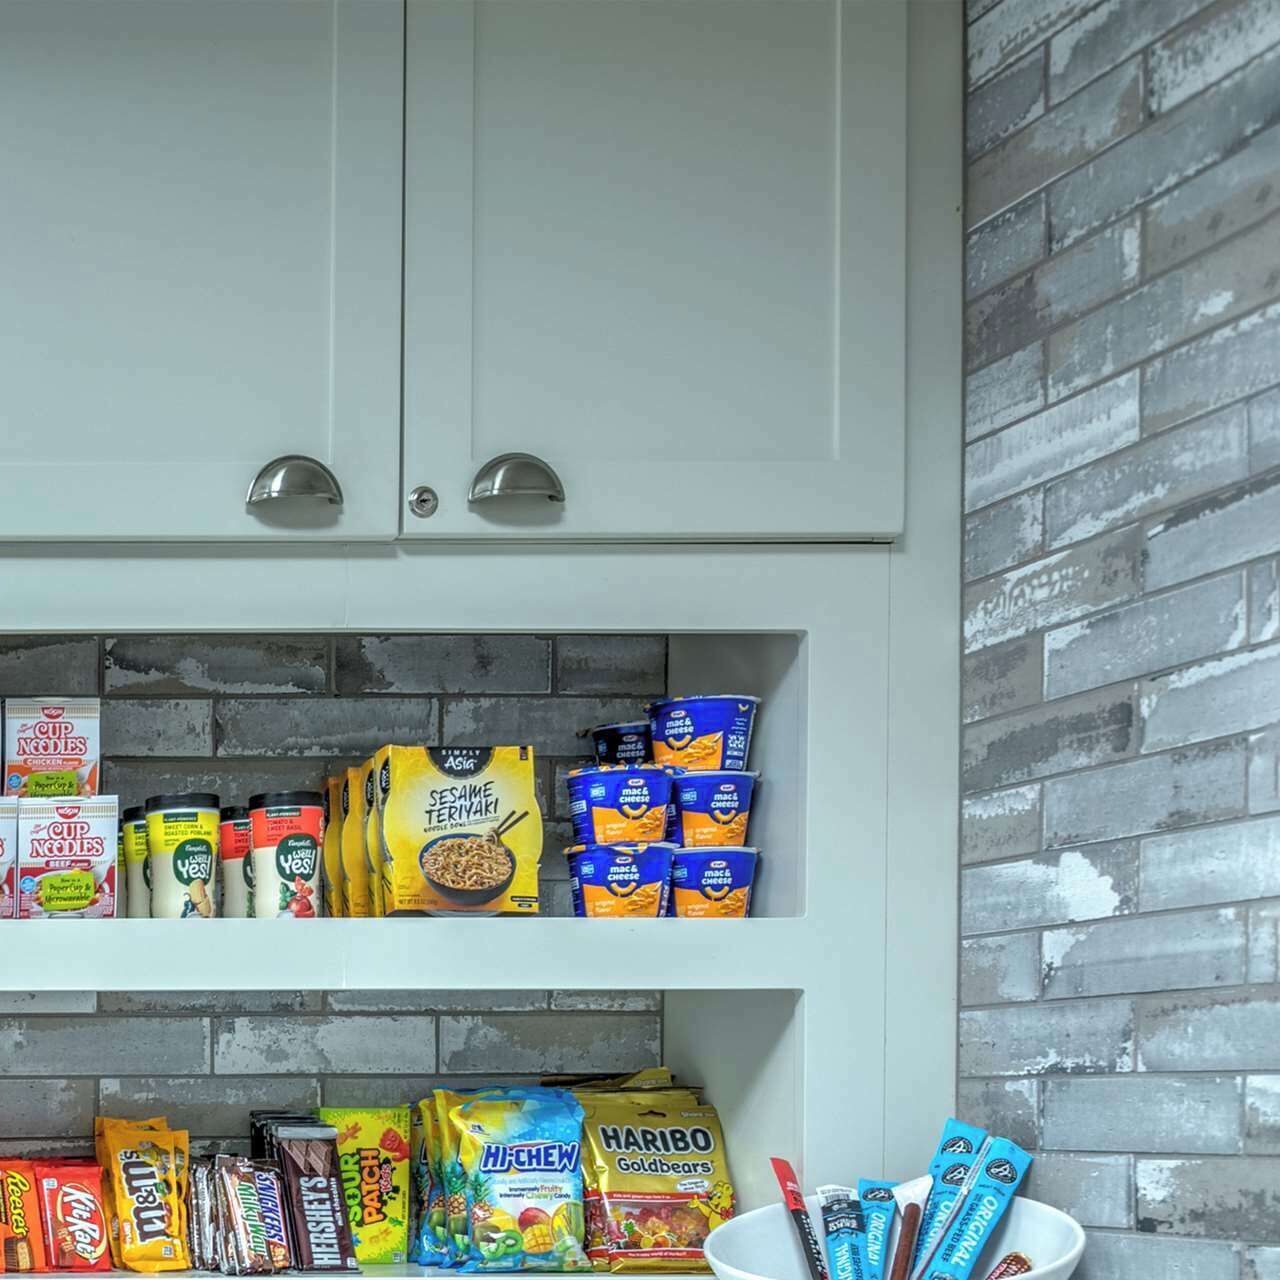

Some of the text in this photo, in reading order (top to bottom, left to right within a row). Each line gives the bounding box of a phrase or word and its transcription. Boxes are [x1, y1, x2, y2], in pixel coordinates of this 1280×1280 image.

[34, 721, 74, 739] CUP
[17, 736, 87, 756] NOODLES
[26, 758, 62, 766] CHICKEN
[444, 756, 476, 770] Asia
[429, 781, 495, 807] SESAME
[425, 798, 499, 825] TERIYAKI
[47, 822, 90, 840] CUP
[30, 837, 104, 857] NOODLES
[49, 860, 71, 868] BEEF
[177, 855, 211, 879] Yes!
[280, 849, 316, 874] Yes!
[600, 1126, 713, 1154] HARIBO
[480, 1142, 579, 1173] HI-CHEW
[617, 1157, 713, 1175] Goldbears
[340, 1154, 361, 1222] SOUR
[359, 1149, 385, 1225] PATCH
[379, 1164, 392, 1193] Kids
[540, 1185, 563, 1193] Fruity
[5, 1169, 30, 1237] Reese's
[255, 1171, 286, 1246] SNICKERS
[300, 1175, 341, 1265] HERSHEY'S
[951, 1196, 998, 1267] ORIGINAL
[941, 1242, 957, 1263] BEEF
